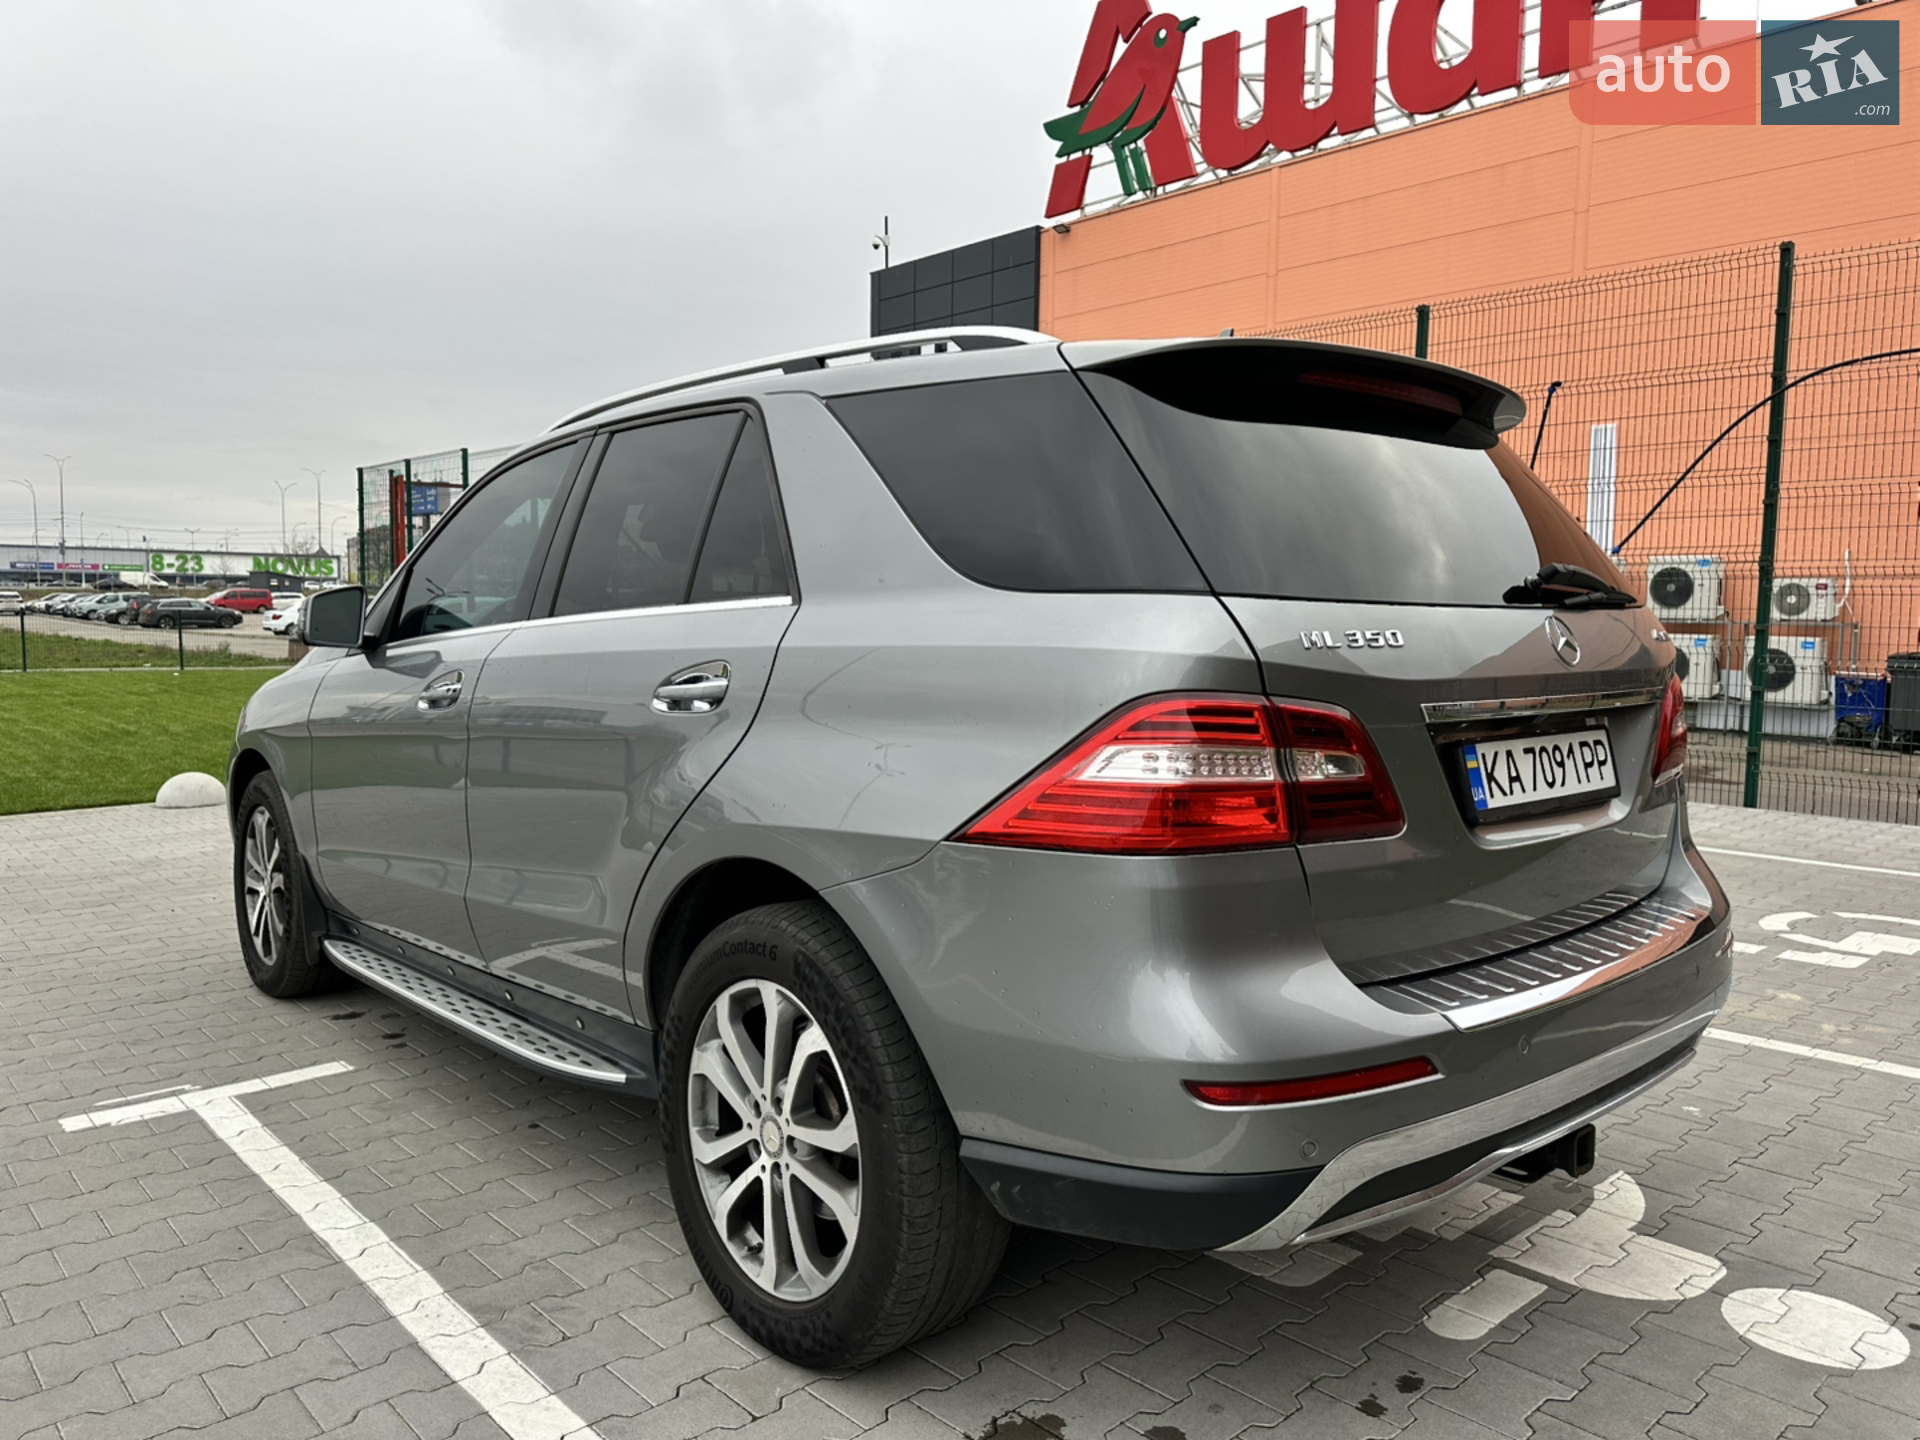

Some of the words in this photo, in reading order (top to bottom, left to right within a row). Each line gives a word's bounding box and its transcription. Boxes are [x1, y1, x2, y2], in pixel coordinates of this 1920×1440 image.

[151, 553, 204, 573] 8-23
[253, 556, 335, 577] NOVUS
[1299, 630, 1342, 650] ML
[1344, 629, 1405, 648] 350
[1472, 787, 1486, 801] UA
[769, 944, 779, 962] 6
